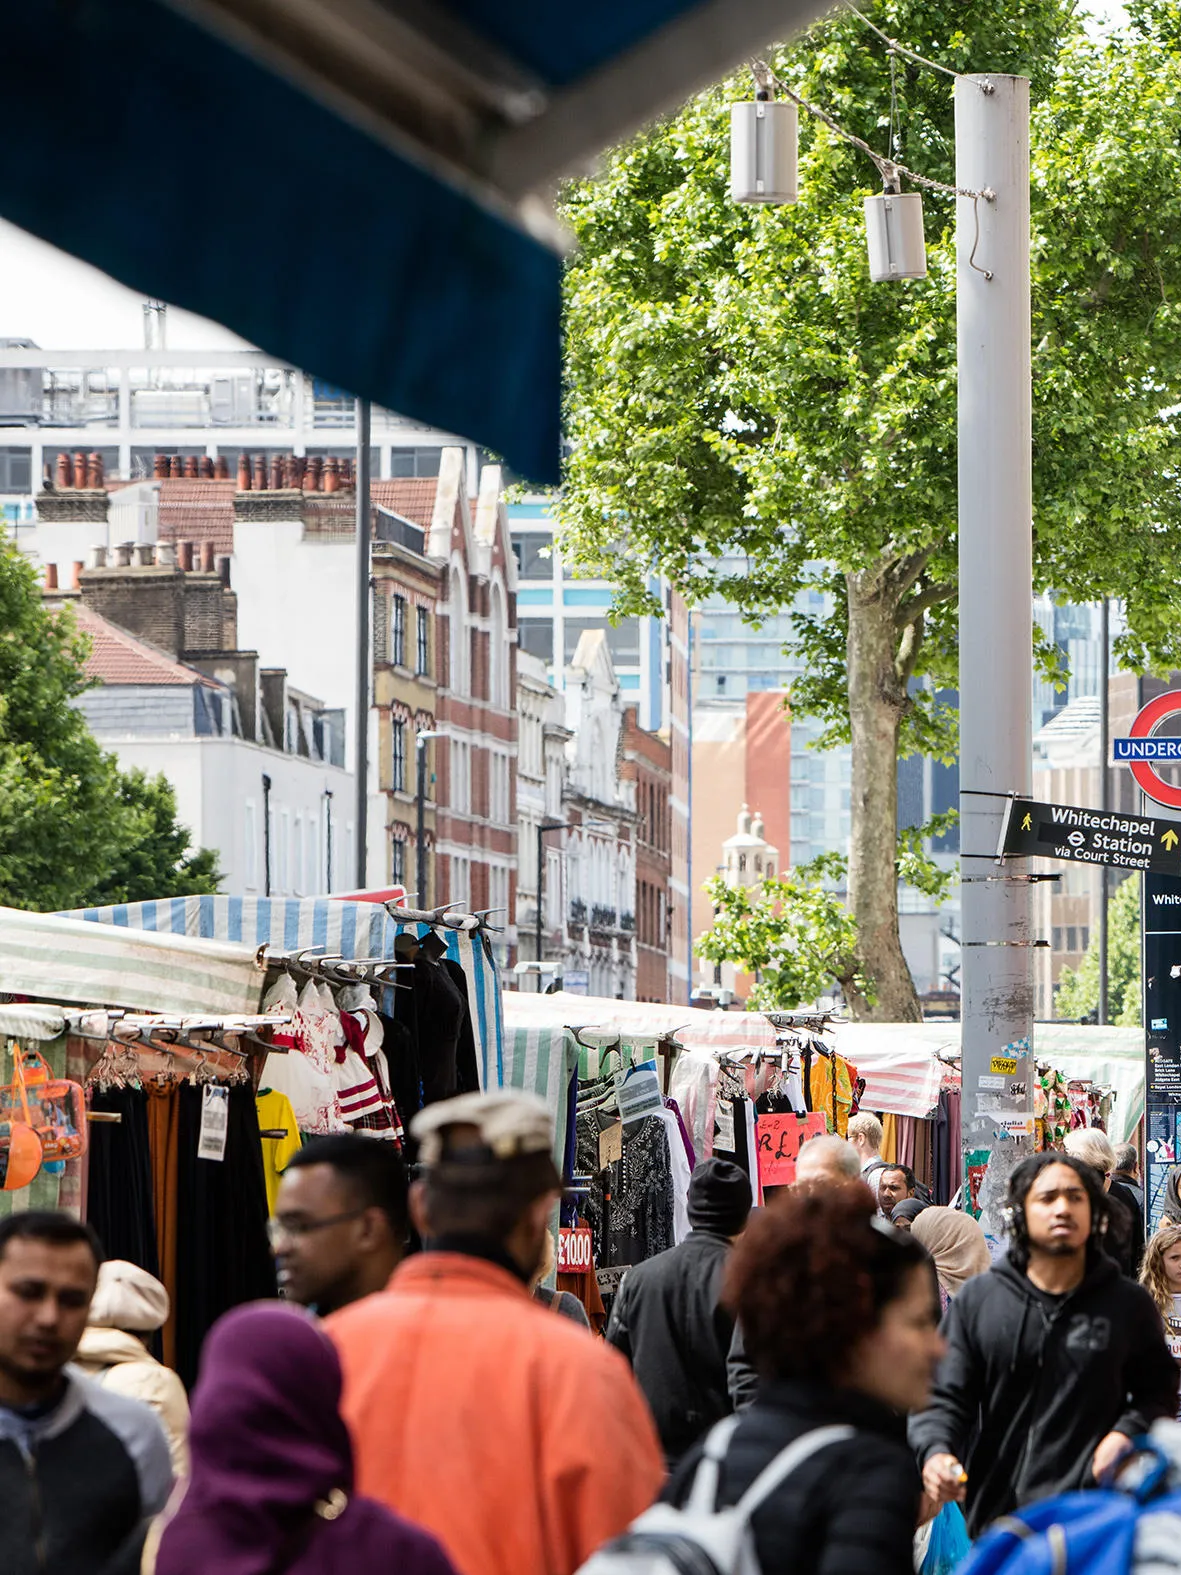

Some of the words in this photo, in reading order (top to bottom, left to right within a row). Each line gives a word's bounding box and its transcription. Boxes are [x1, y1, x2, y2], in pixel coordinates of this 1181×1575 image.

[1050, 808, 1156, 836] Whitechapel
[1092, 832, 1152, 856] Station
[1054, 846, 1071, 858] via
[1074, 847, 1108, 862] Court
[1112, 852, 1151, 869] Street
[558, 1234, 591, 1266] £10.00
